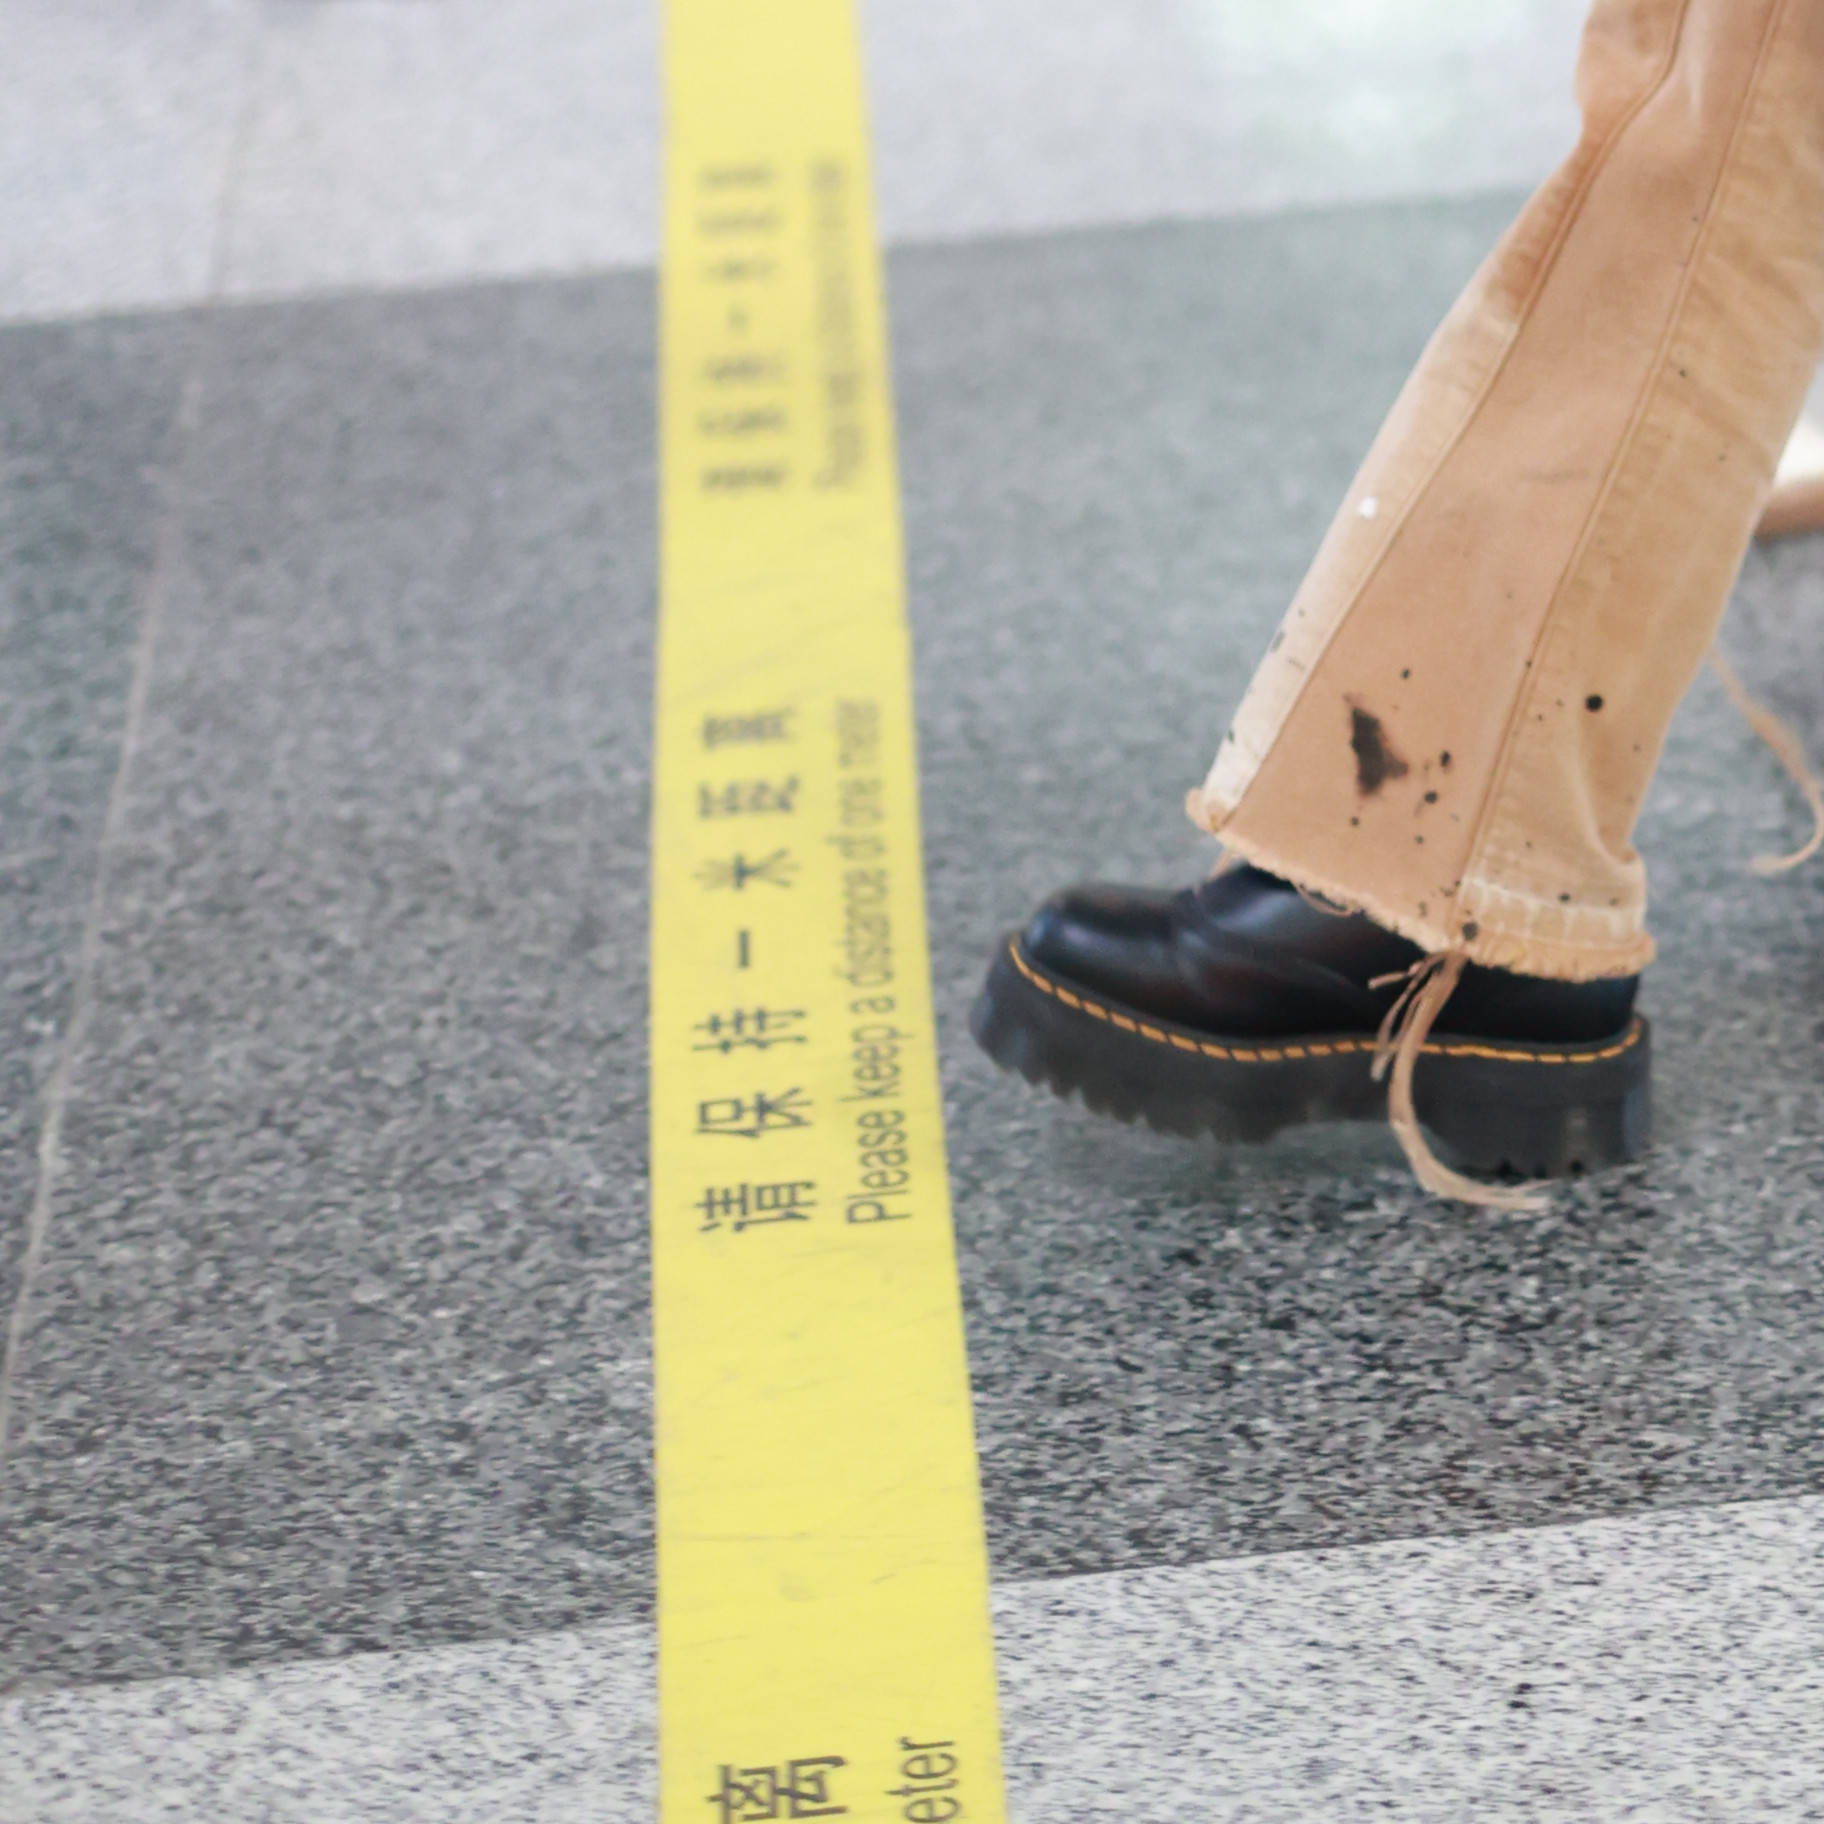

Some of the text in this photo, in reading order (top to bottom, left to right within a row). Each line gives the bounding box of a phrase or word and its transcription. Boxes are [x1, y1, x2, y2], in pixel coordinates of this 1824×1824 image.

[830, 866, 894, 988] distance
[850, 995, 896, 1014] a
[838, 1025, 914, 1103] keep
[844, 1106, 914, 1226] Please
[883, 1736, 961, 1824] eter
